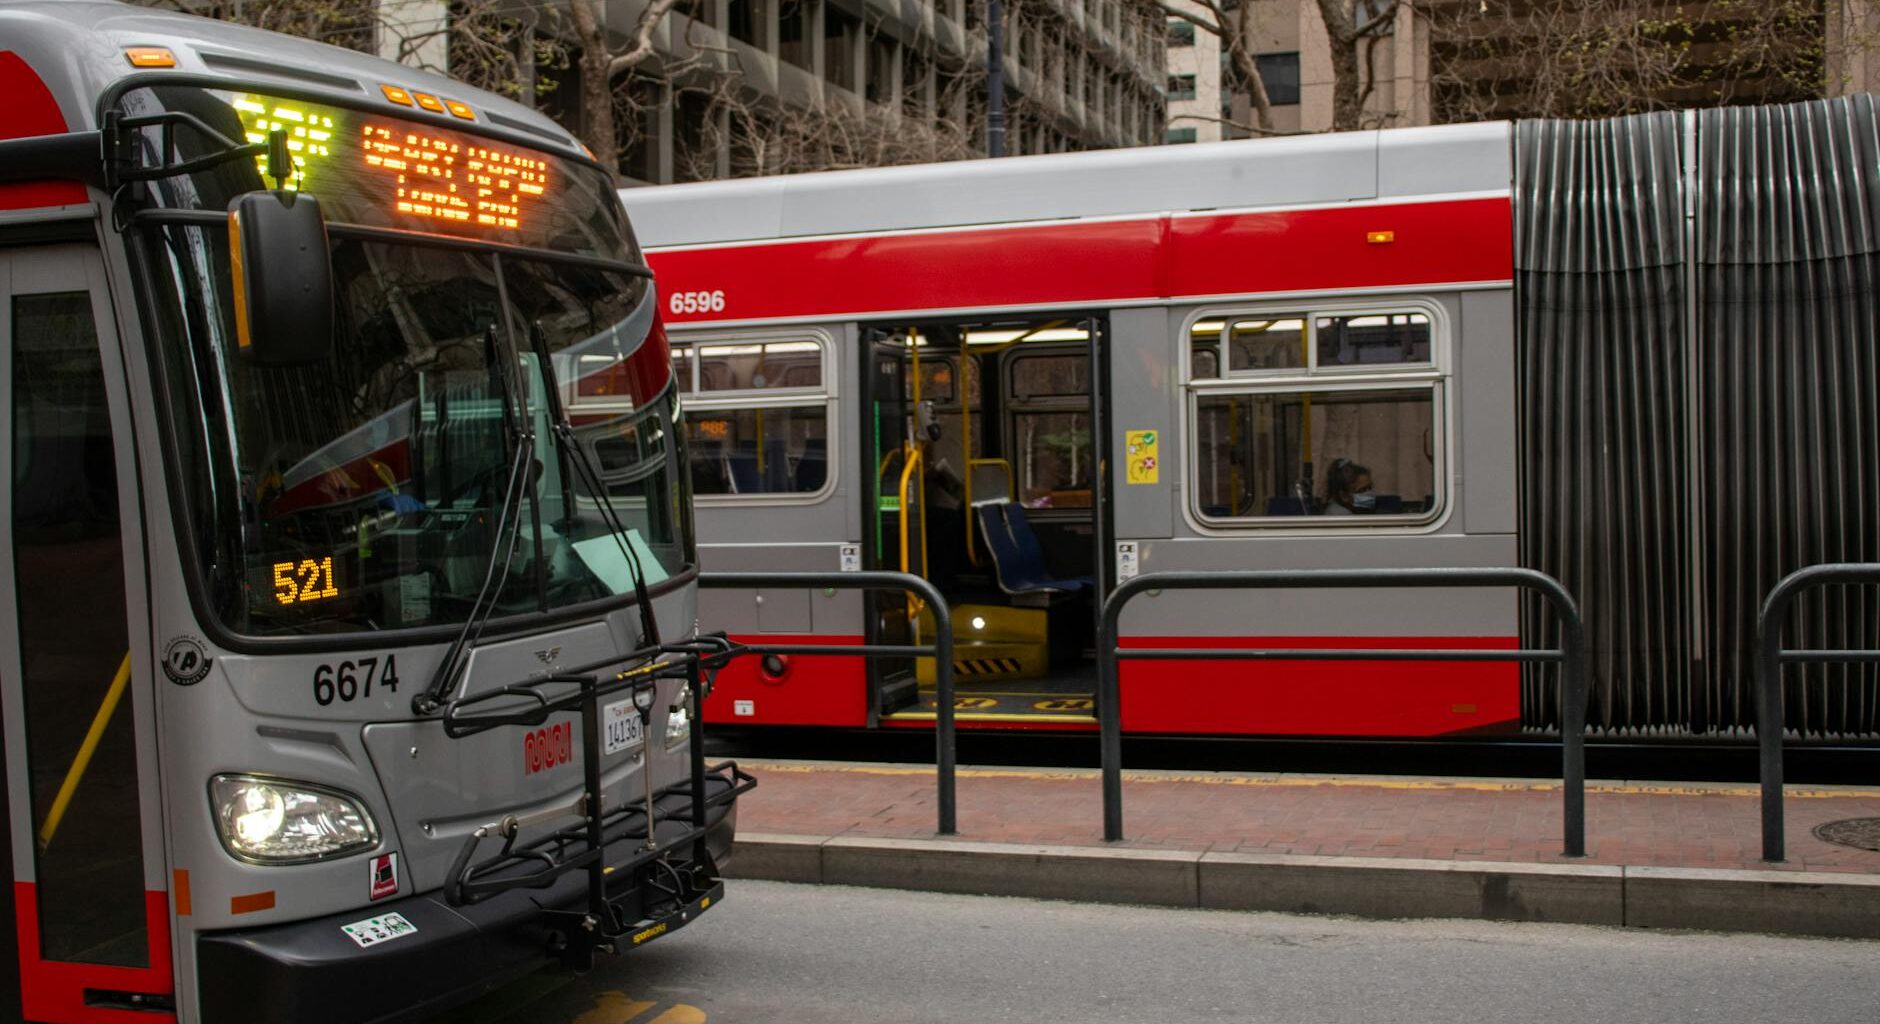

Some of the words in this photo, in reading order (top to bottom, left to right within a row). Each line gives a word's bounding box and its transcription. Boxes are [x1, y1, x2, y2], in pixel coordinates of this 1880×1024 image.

[670, 289, 725, 315] 6596
[273, 556, 338, 605] 521
[313, 653, 399, 706] 6674
